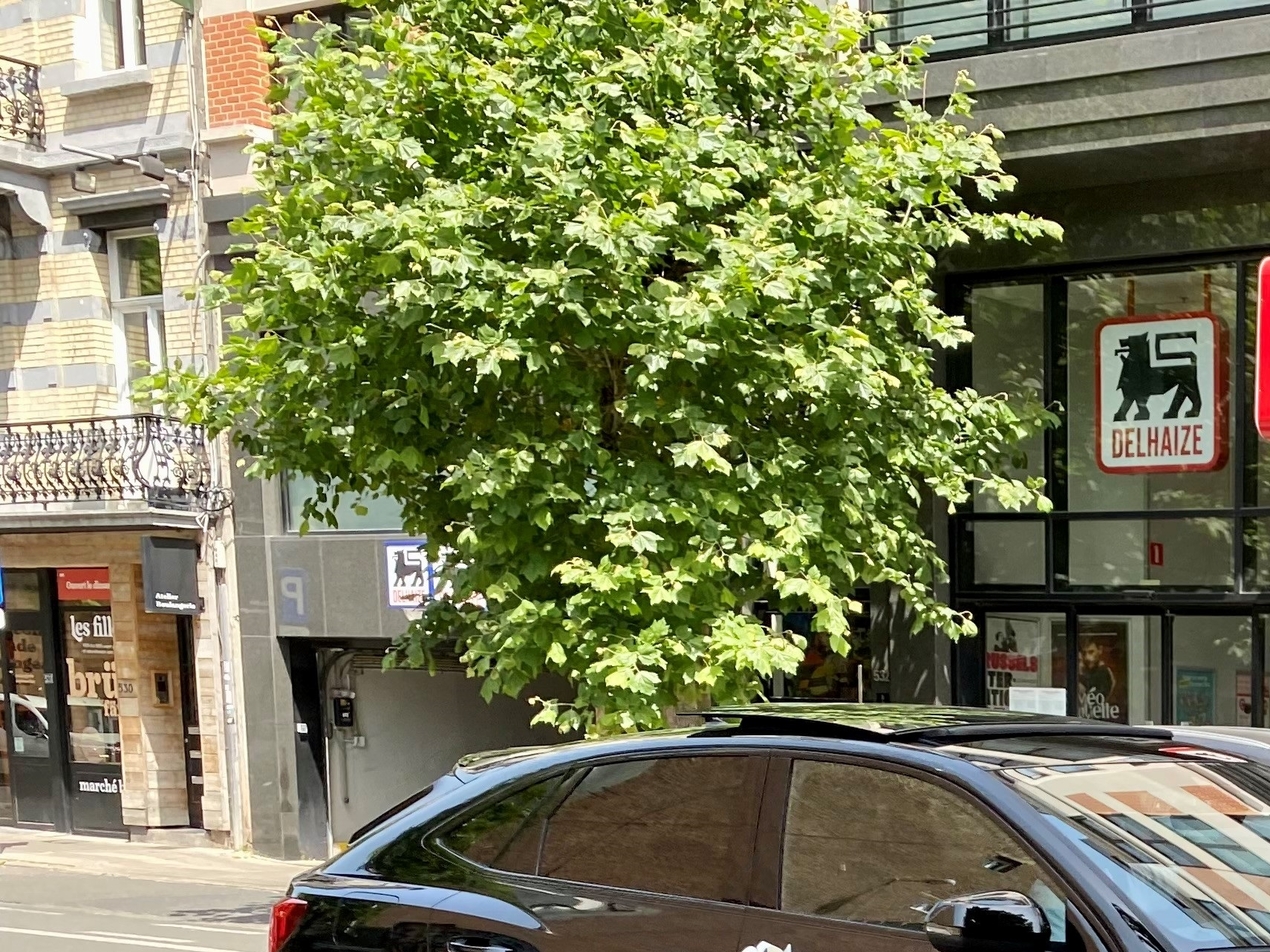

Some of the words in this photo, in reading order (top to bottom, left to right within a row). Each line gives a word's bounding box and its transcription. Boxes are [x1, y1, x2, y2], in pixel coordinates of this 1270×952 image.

[1111, 423, 1204, 459] DELHAIZE
[69, 614, 91, 643] les
[118, 683, 134, 694] 530
[79, 778, 118, 794] marché
